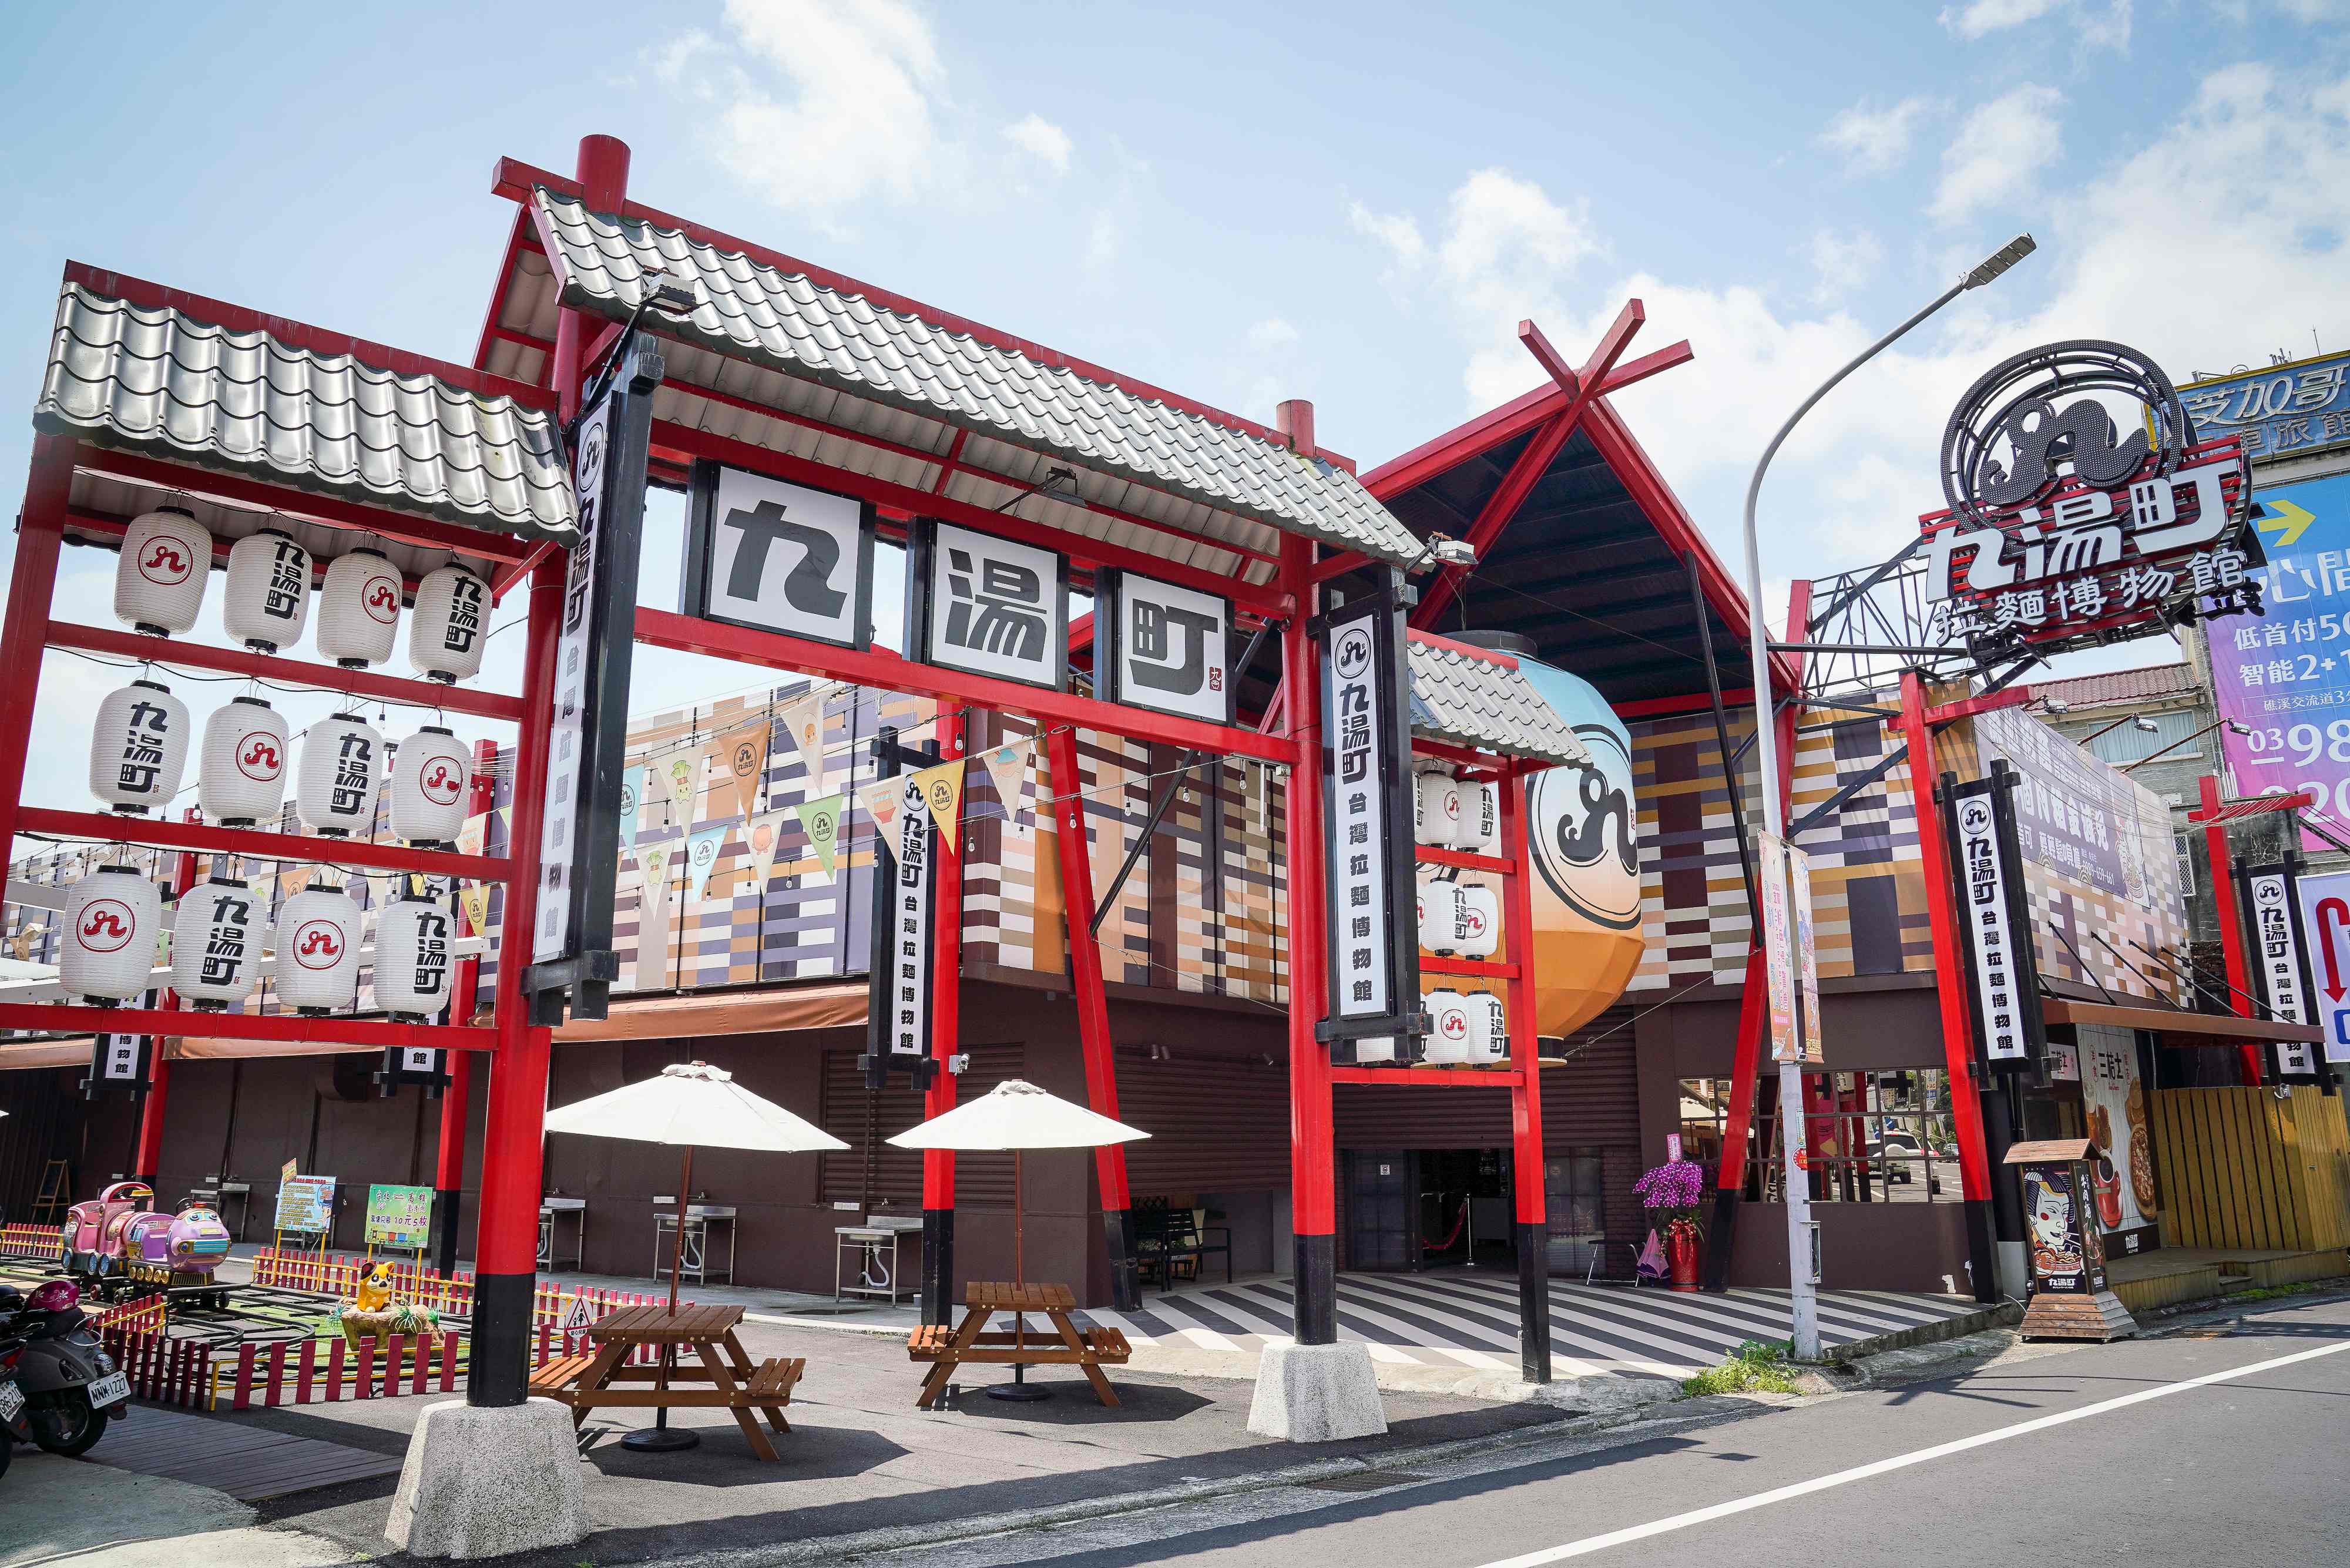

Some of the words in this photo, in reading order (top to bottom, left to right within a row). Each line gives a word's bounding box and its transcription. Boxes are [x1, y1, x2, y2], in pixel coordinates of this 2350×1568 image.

[1915, 458, 2242, 603] 九湯町
[264, 540, 305, 620] 九湯町
[445, 576, 482, 653] 九湯町
[1933, 549, 2248, 646] 拉麵博物館
[118, 701, 169, 793] 九湯町
[330, 733, 371, 815] 九湯町
[1340, 683, 1371, 785] 九湯町
[545, 644, 579, 939] 台灣拉麵博物館
[1480, 786, 1493, 837] 九湯町
[901, 813, 926, 888] 九湯町
[1967, 837, 1997, 905] 九湯町
[1348, 792, 1372, 1002] 台灣拉麵博物館
[1452, 888, 1468, 940] 九湯町
[2261, 906, 2289, 959] 九湯町
[200, 895, 249, 986] 九湯町
[413, 911, 448, 994] 九湯町
[900, 895, 918, 1049] 台灣拉麵博物館
[1981, 911, 2013, 1050] 台灣拉麵博物館
[115, 1035, 132, 1074] 博物館
[1488, 1000, 1503, 1054] 九湯町
[2274, 962, 2305, 1067] 台灣拉麵物館
[91, 1377, 126, 1403] NNM-1227
